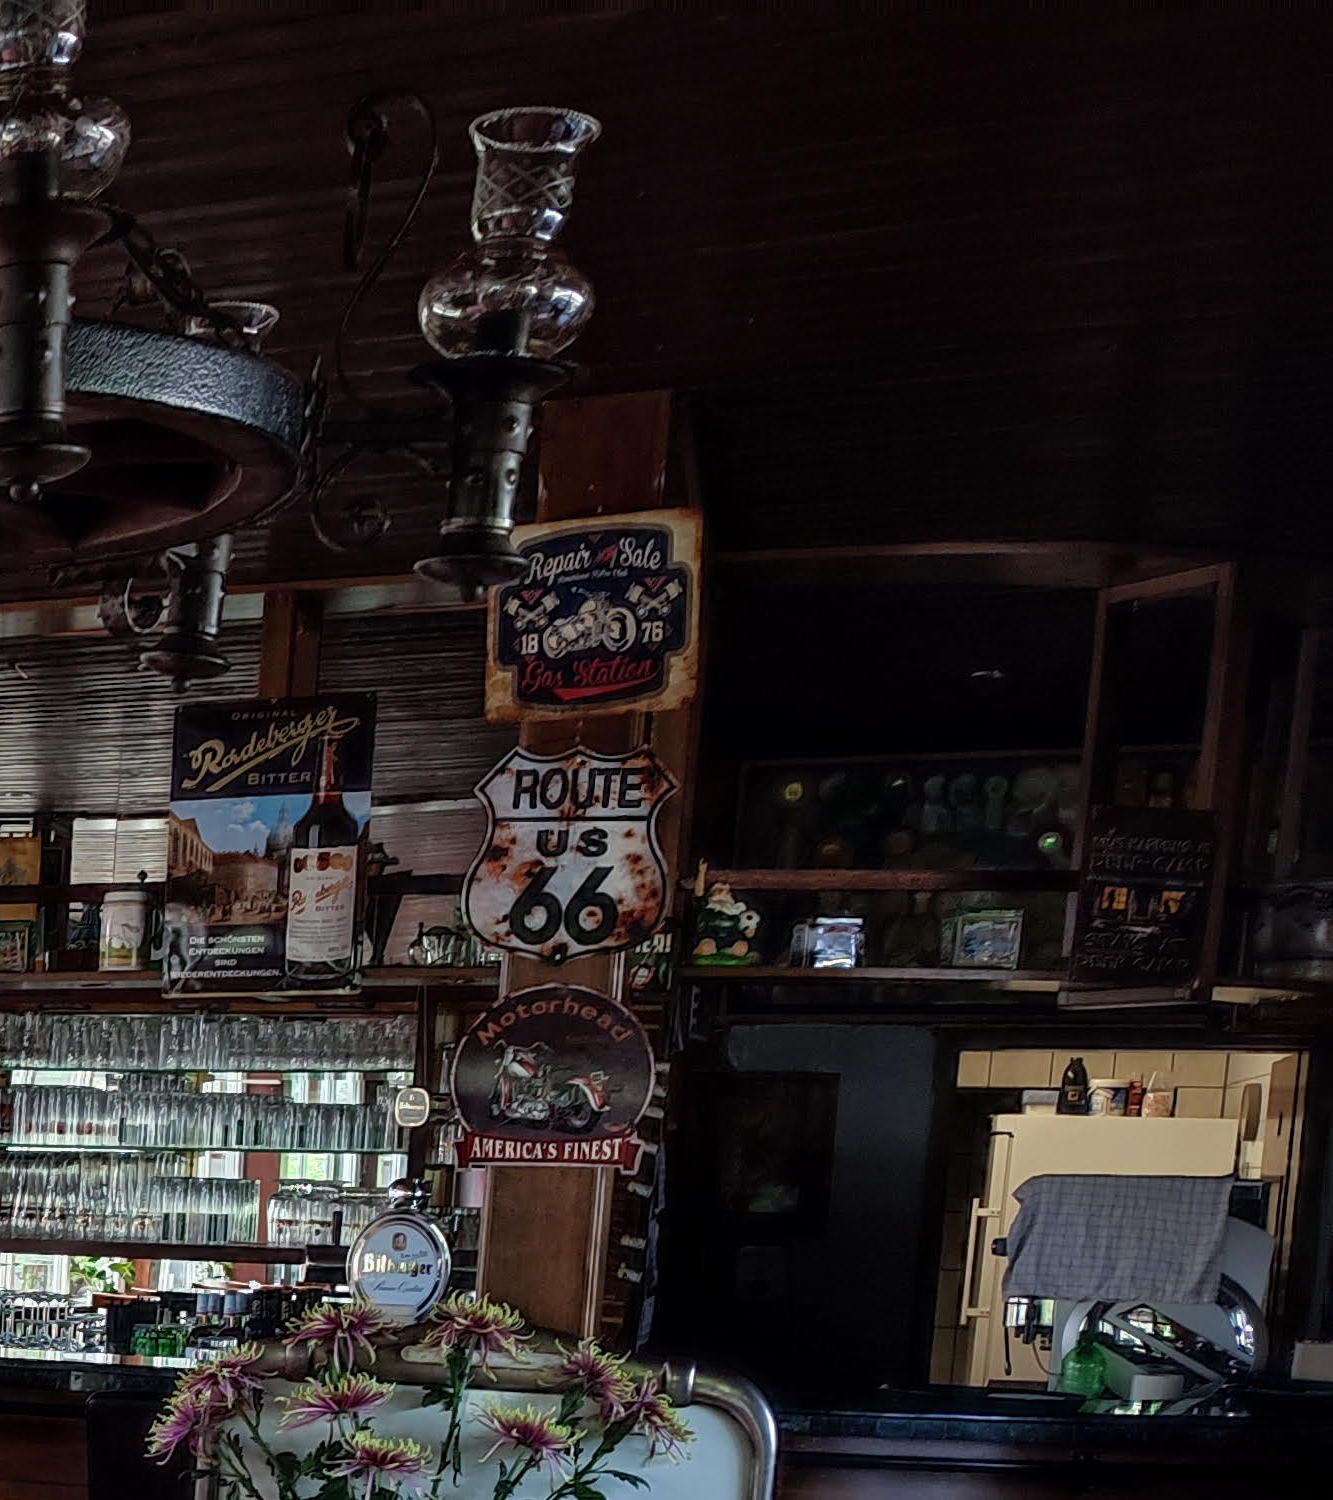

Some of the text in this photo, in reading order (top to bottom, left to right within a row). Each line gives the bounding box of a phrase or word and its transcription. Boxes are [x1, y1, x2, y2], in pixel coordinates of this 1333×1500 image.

[525, 543, 592, 586] Repair
[620, 537, 661, 571] Sale
[522, 620, 664, 655] 18 76
[520, 655, 656, 695] Gas Station
[246, 771, 311, 786] BITTER
[513, 767, 643, 810] ROUTE
[509, 865, 619, 946] 66
[214, 958, 237, 967] SIND
[476, 997, 633, 1046] Motorhead
[470, 1137, 621, 1161] AMERICA'S FINEST
